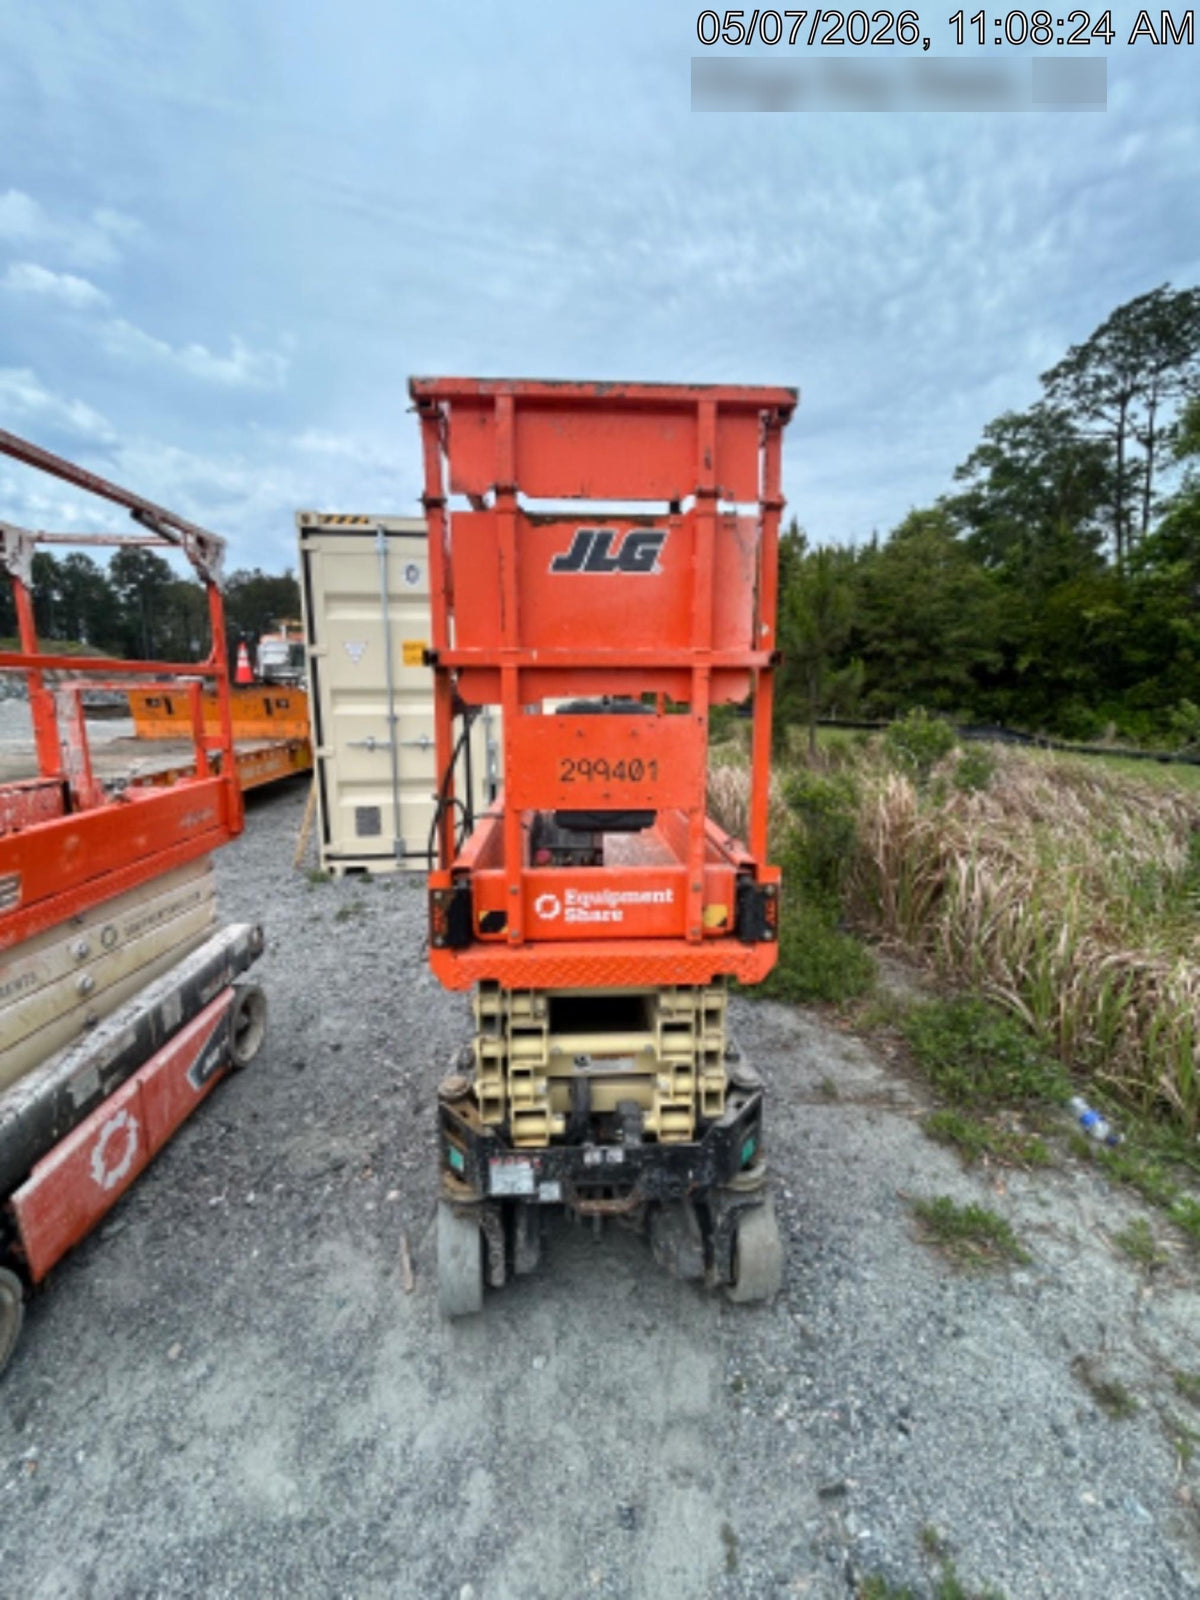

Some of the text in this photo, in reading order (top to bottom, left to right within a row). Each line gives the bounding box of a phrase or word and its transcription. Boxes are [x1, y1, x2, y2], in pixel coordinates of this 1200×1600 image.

[549, 528, 669, 574] JLG
[560, 758, 658, 782] 299401
[564, 889, 673, 908] Equipment
[564, 908, 623, 922] Share
